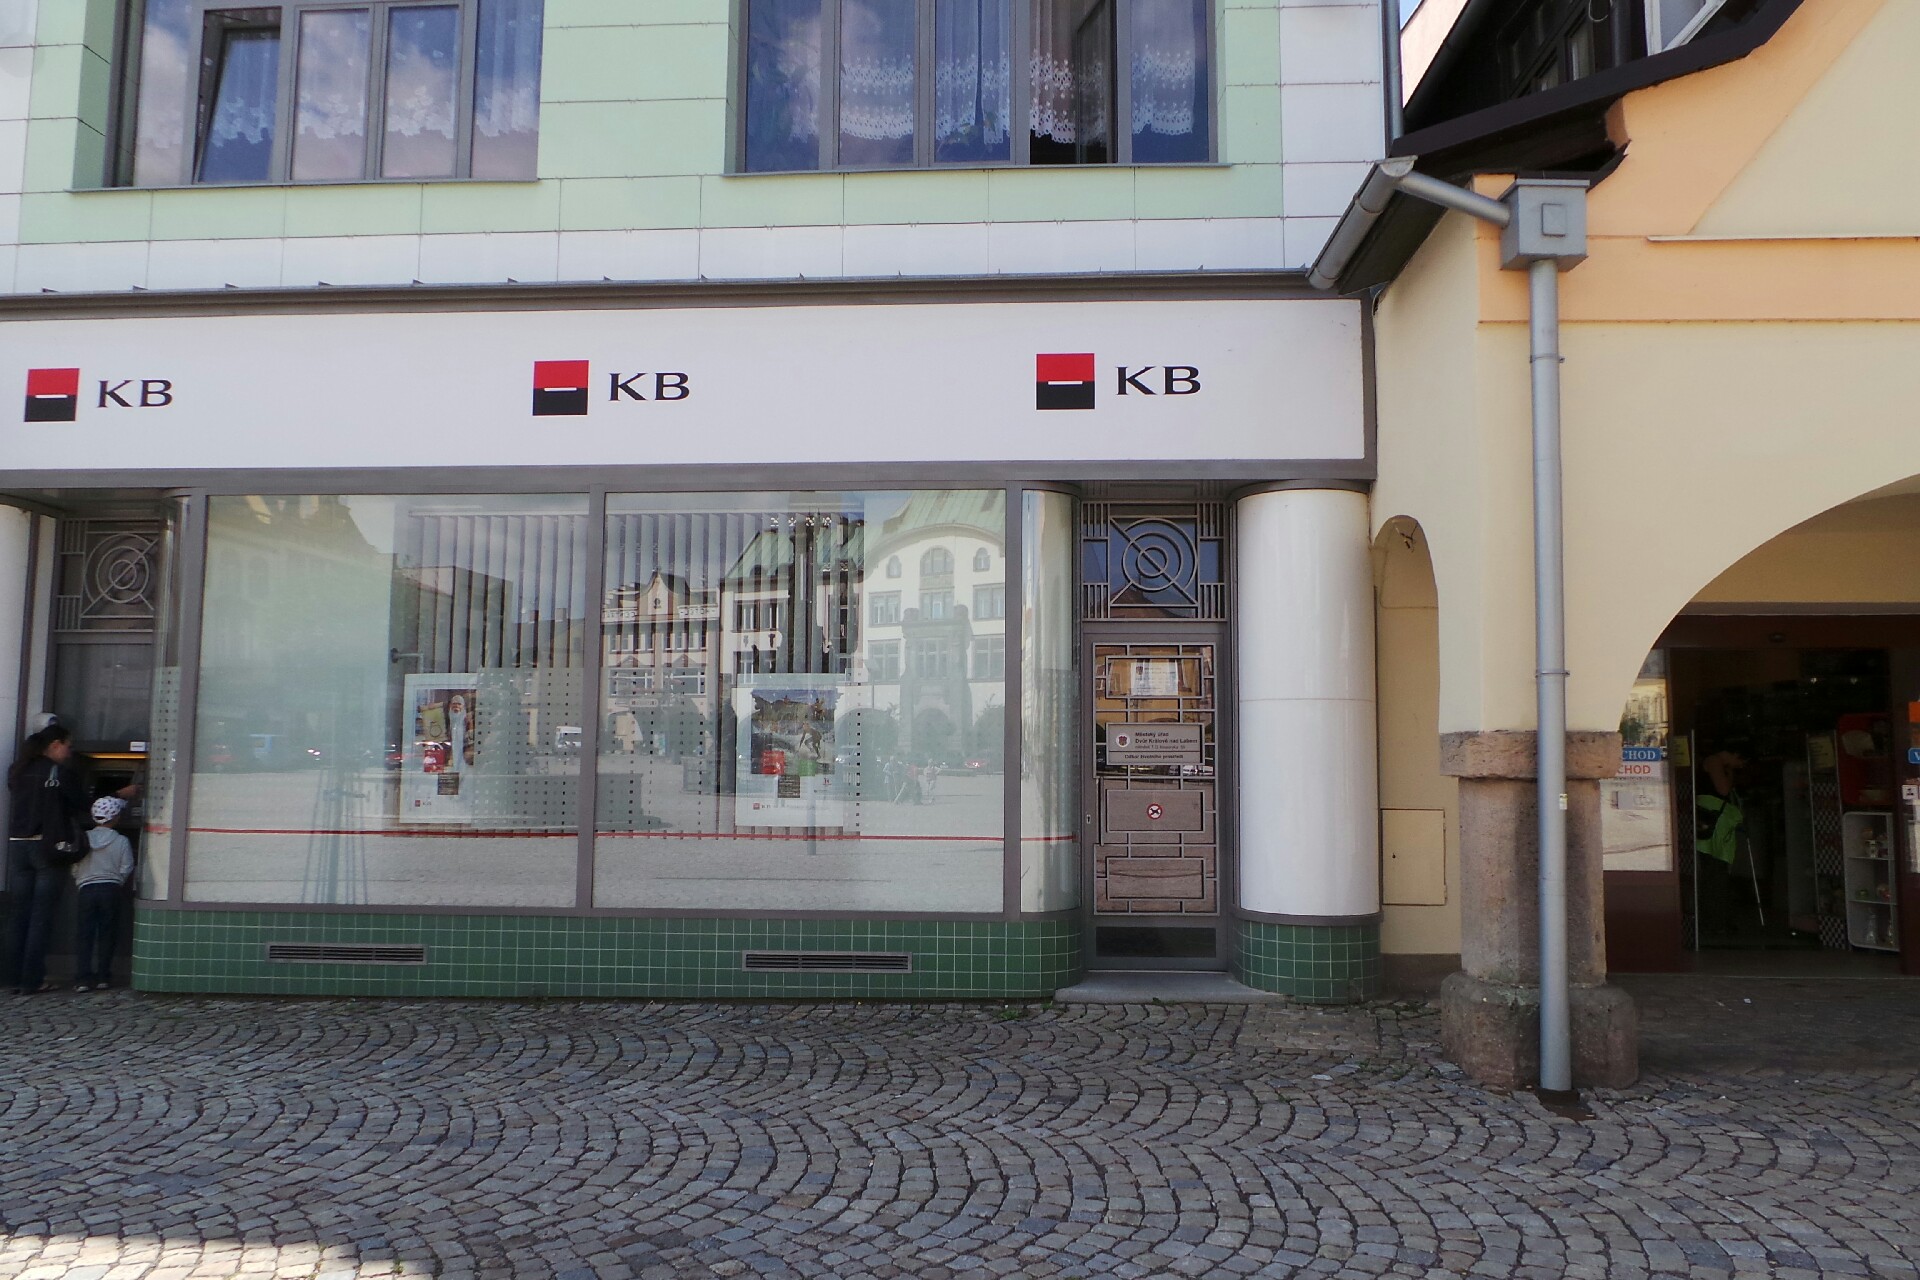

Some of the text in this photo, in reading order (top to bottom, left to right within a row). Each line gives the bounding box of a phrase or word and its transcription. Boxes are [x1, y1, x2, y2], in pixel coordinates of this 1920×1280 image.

[97, 379, 173, 408] KB
[608, 372, 690, 401] KB
[1115, 366, 1201, 395] KB
[1617, 765, 1651, 774] CHOD
[1622, 751, 1656, 760] CHOD
